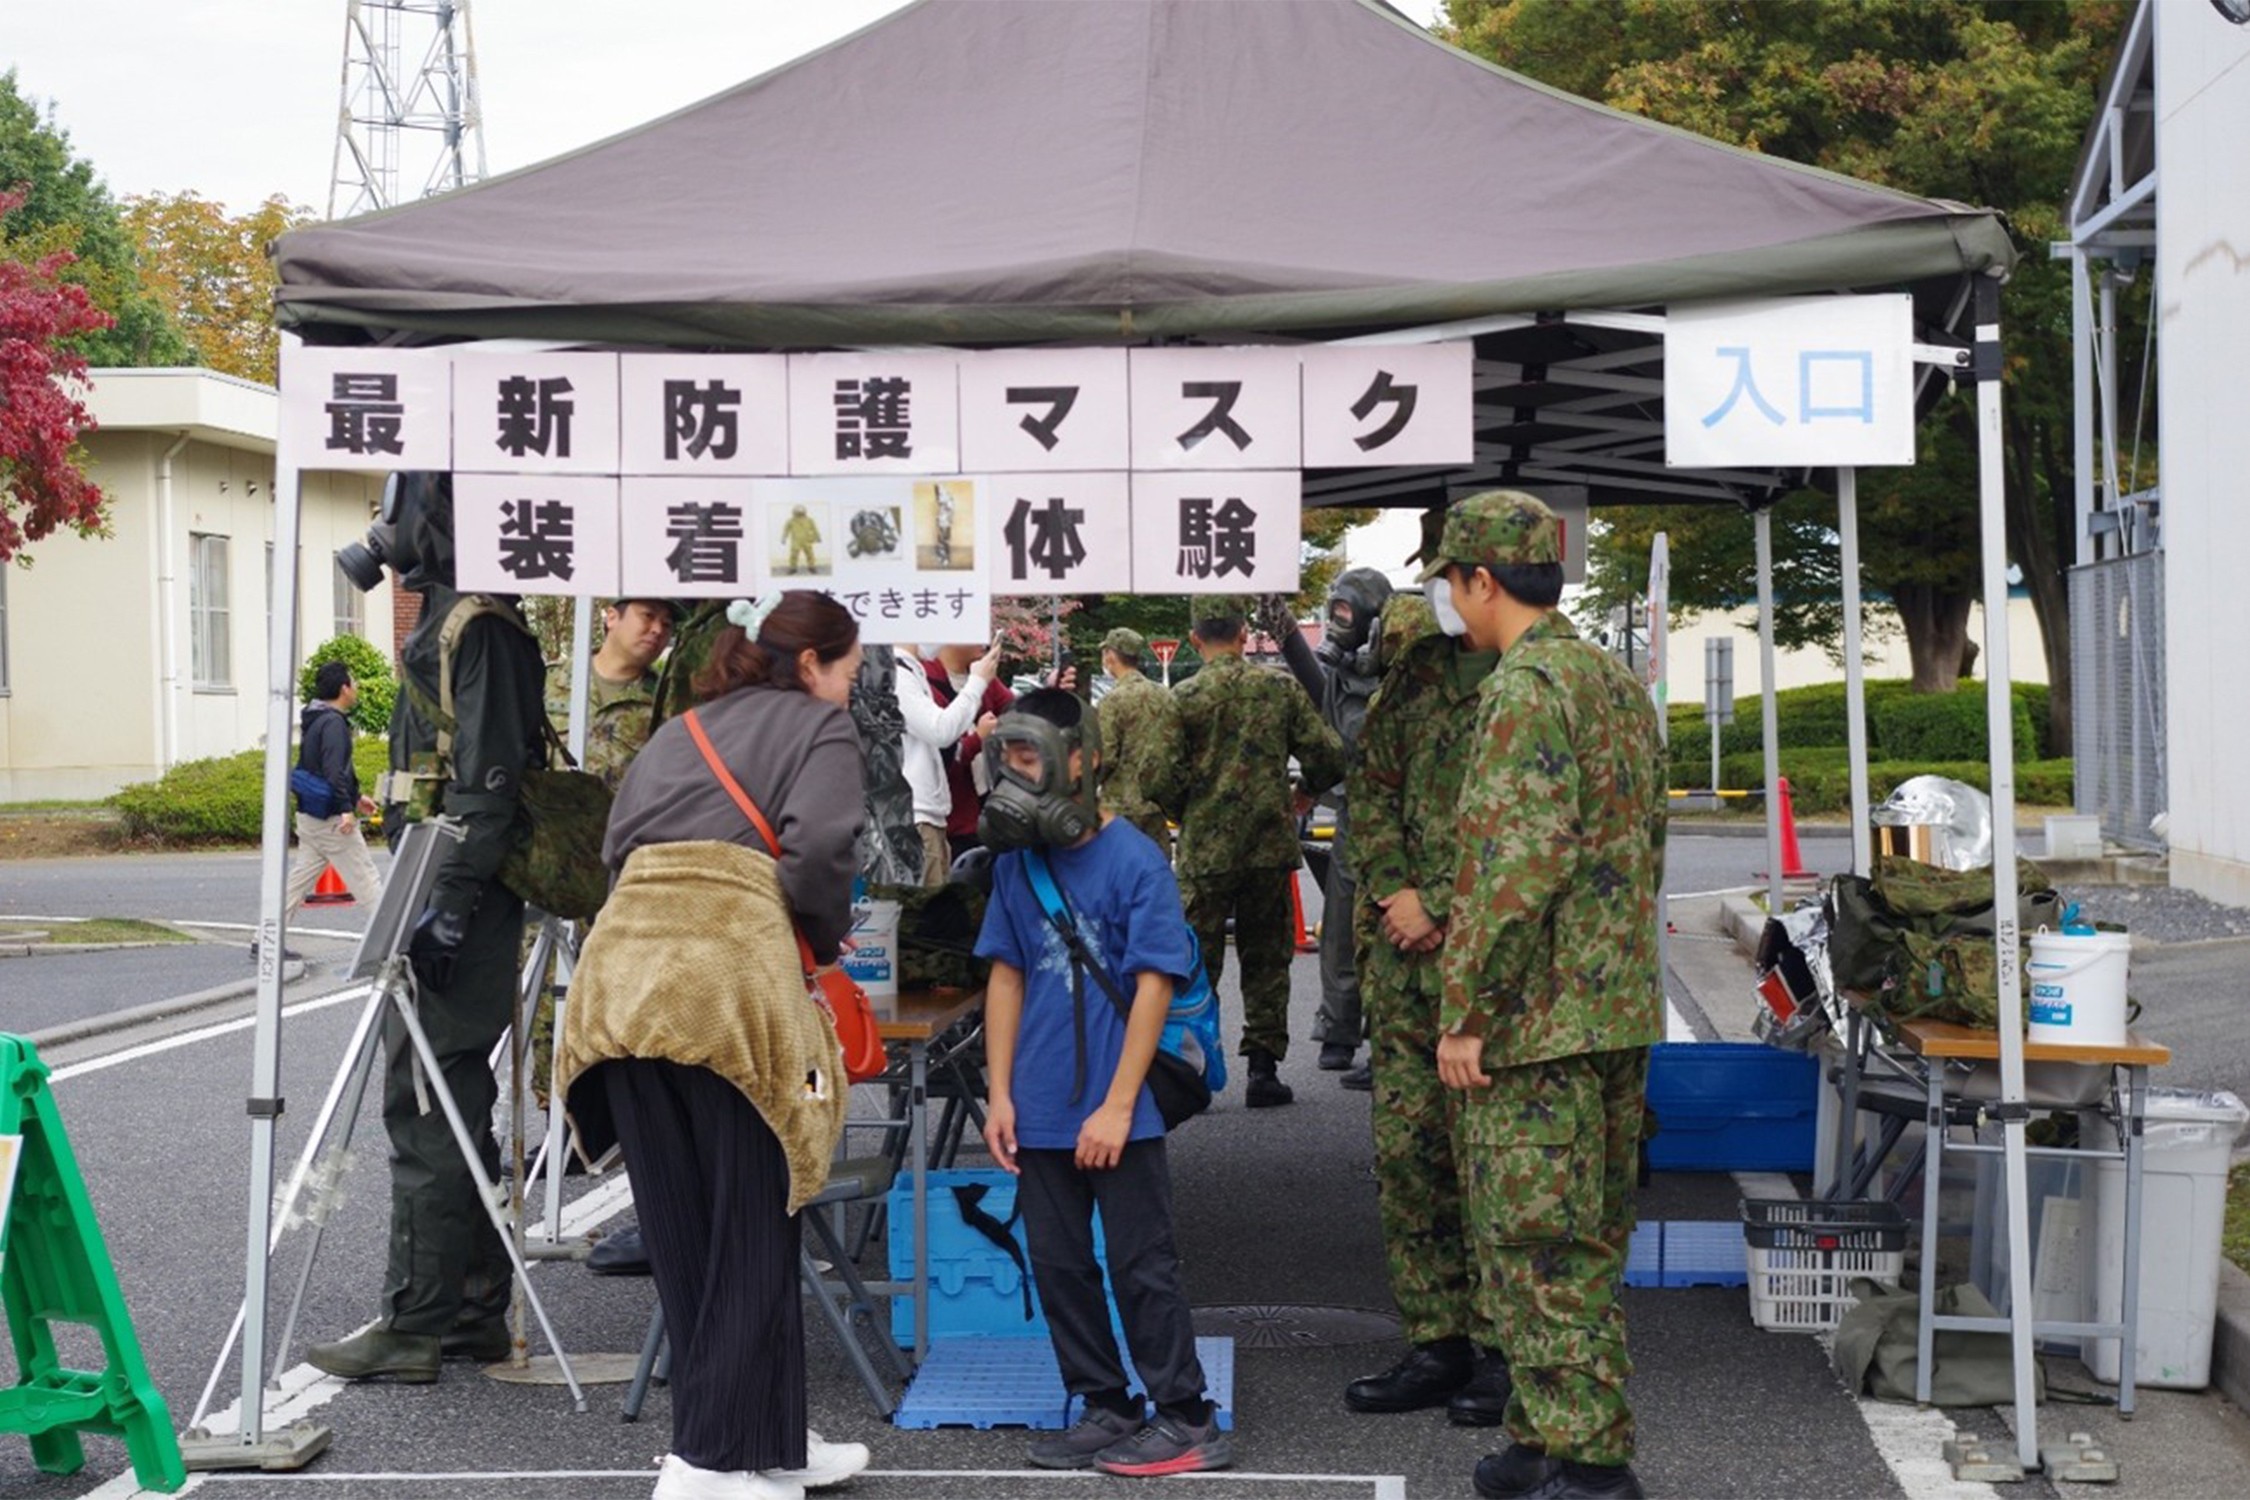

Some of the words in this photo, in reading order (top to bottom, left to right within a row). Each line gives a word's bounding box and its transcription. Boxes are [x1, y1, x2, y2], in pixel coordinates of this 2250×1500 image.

[325, 370, 1418, 460] 最新防護マスク
[1702, 347, 1874, 428] 入口
[824, 587, 973, 619] できます
